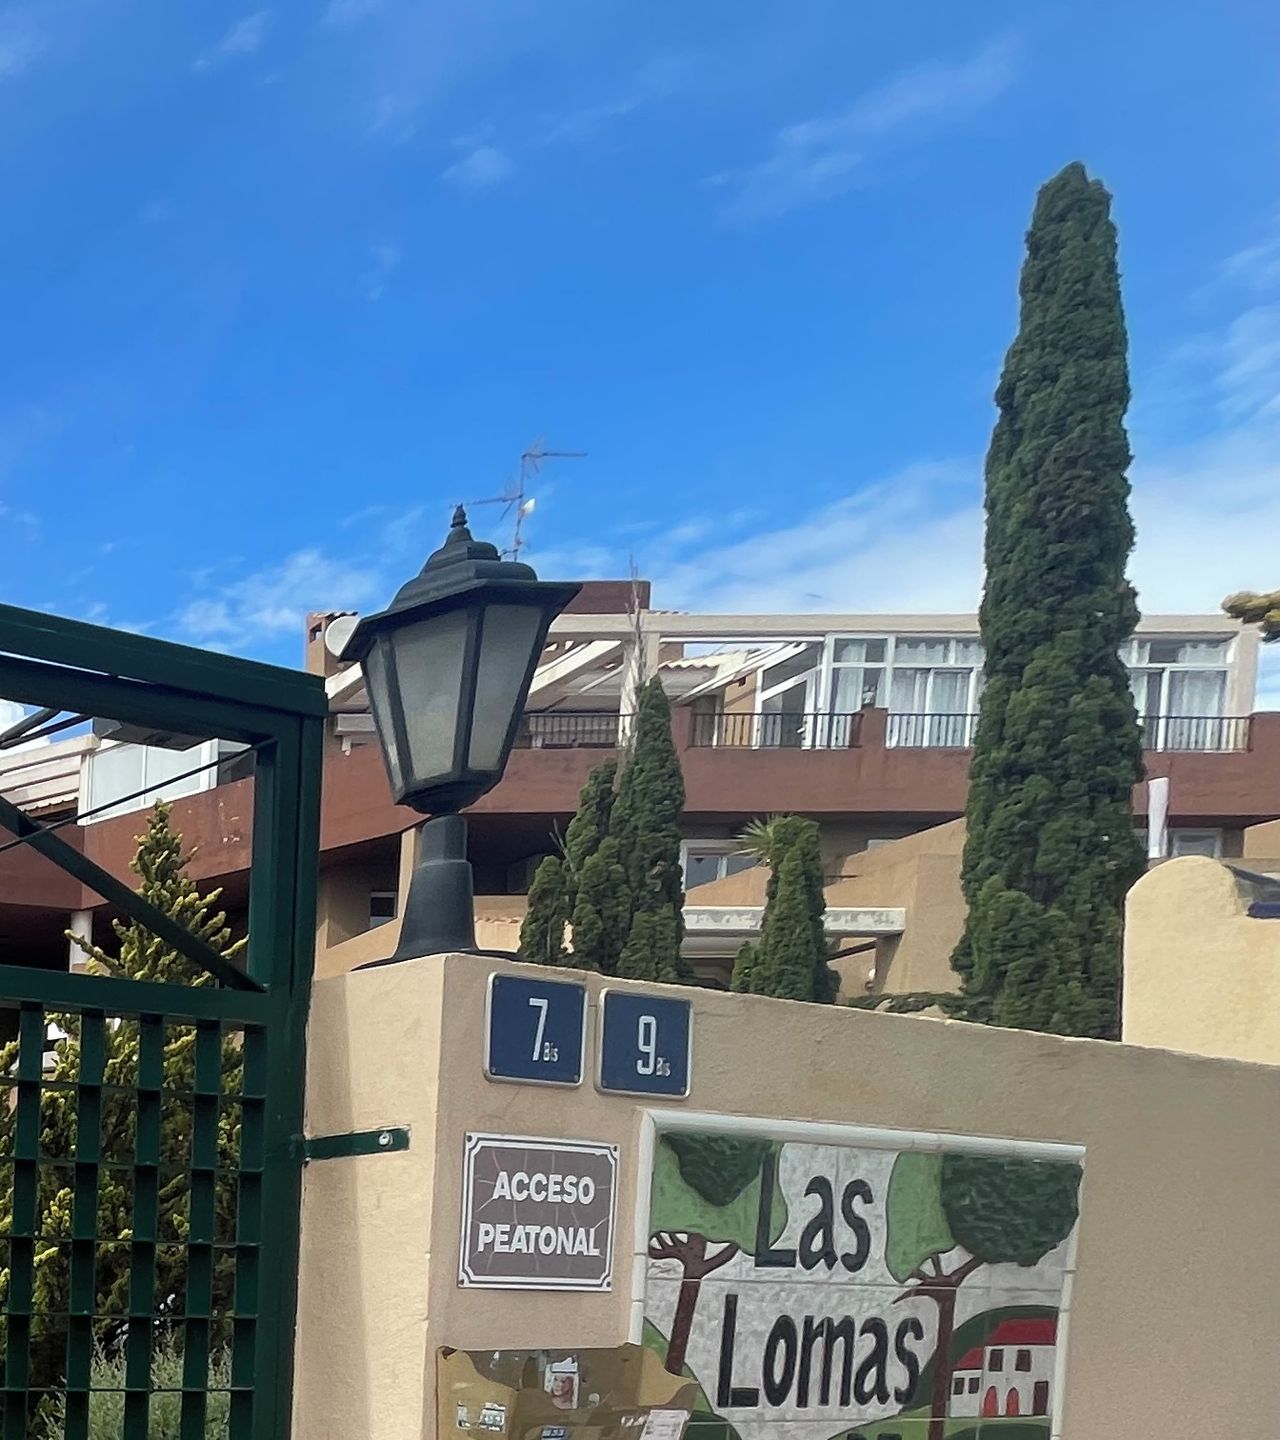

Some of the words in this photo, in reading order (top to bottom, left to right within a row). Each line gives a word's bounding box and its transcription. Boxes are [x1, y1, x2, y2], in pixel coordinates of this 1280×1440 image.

[528, 997, 549, 1062] 7
[636, 1015, 658, 1076] 9
[492, 1171, 596, 1206] ACCESO
[754, 1152, 874, 1273] Las
[478, 1222, 601, 1257] PEATONAL
[716, 1294, 925, 1409] Lomas
